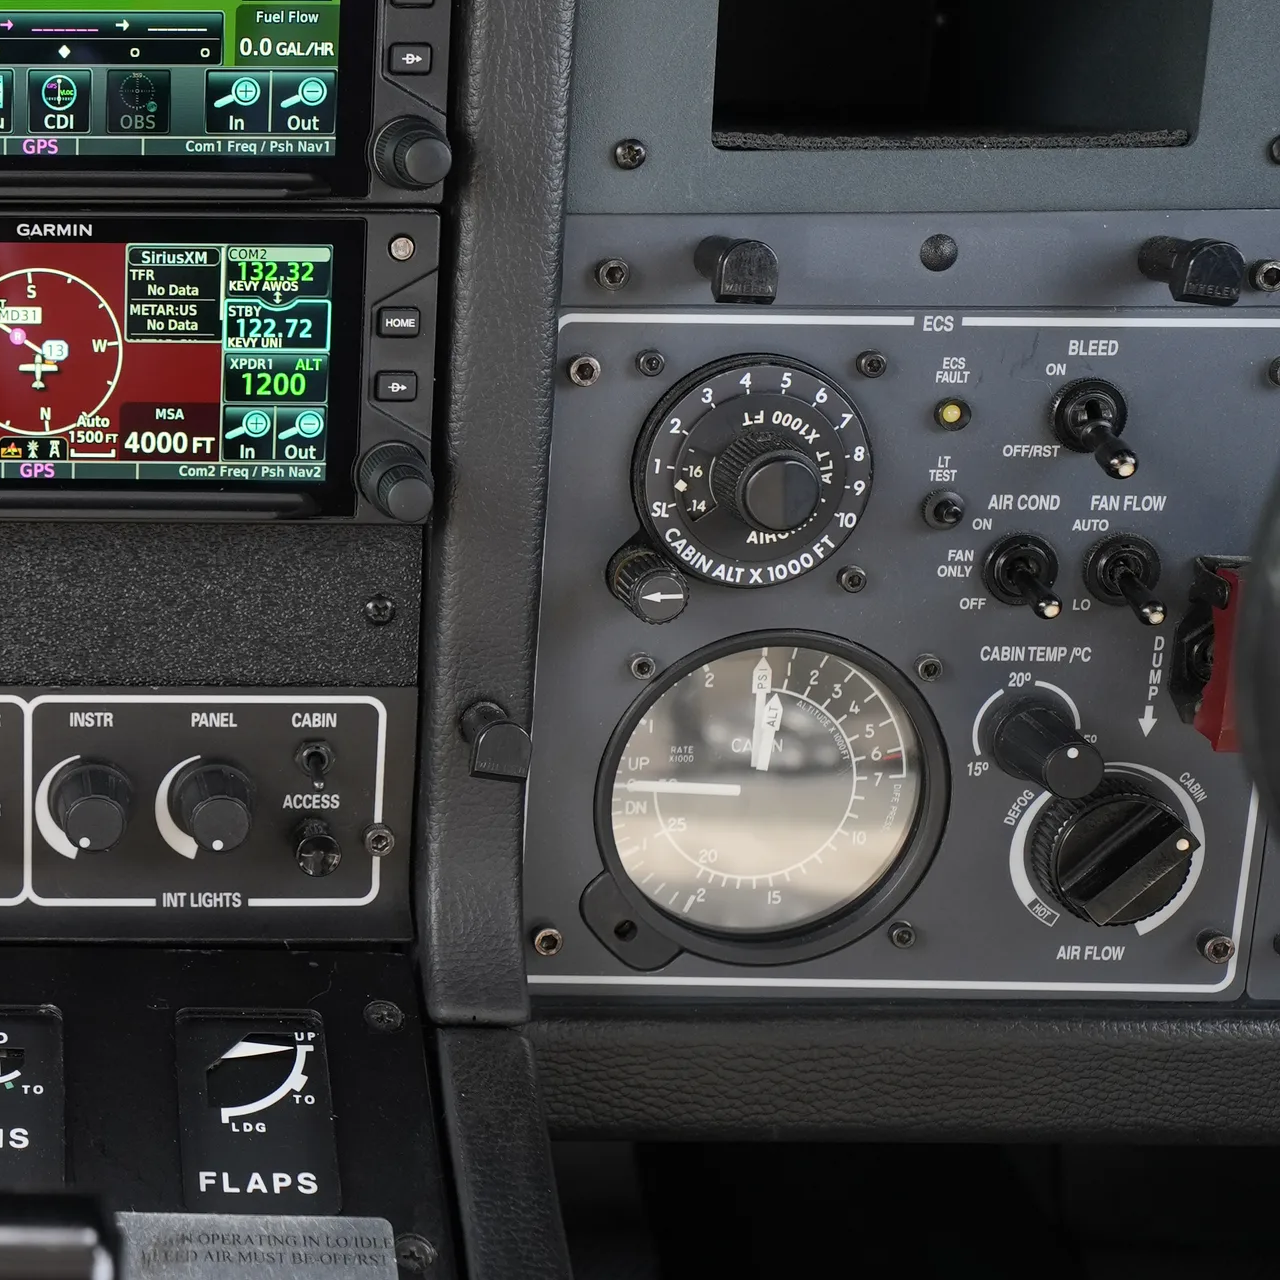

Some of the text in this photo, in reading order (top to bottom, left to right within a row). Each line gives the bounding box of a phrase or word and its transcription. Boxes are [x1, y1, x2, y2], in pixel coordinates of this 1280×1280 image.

[256, 11, 318, 23] Fuel Flow
[22, 139, 58, 154] GPS
[141, 251, 207, 264] SiriusXM
[238, 262, 314, 282] 132.32
[236, 319, 312, 338] 122.72
[386, 319, 415, 327] HOME
[923, 316, 954, 331] ECS
[1069, 341, 1119, 356] BLEED
[241, 374, 305, 395] 1200
[988, 495, 1061, 510] AIR COND
[1091, 496, 1166, 511] FAN FLOW
[70, 713, 113, 727] INSTR
[191, 713, 237, 727] PANEL
[292, 713, 337, 728] CABIN
[283, 794, 339, 808] ACCESS
[163, 893, 241, 908] INT LIGHTS
[1057, 946, 1125, 960] AIR FLOW
[199, 1171, 318, 1194] FLAPS
